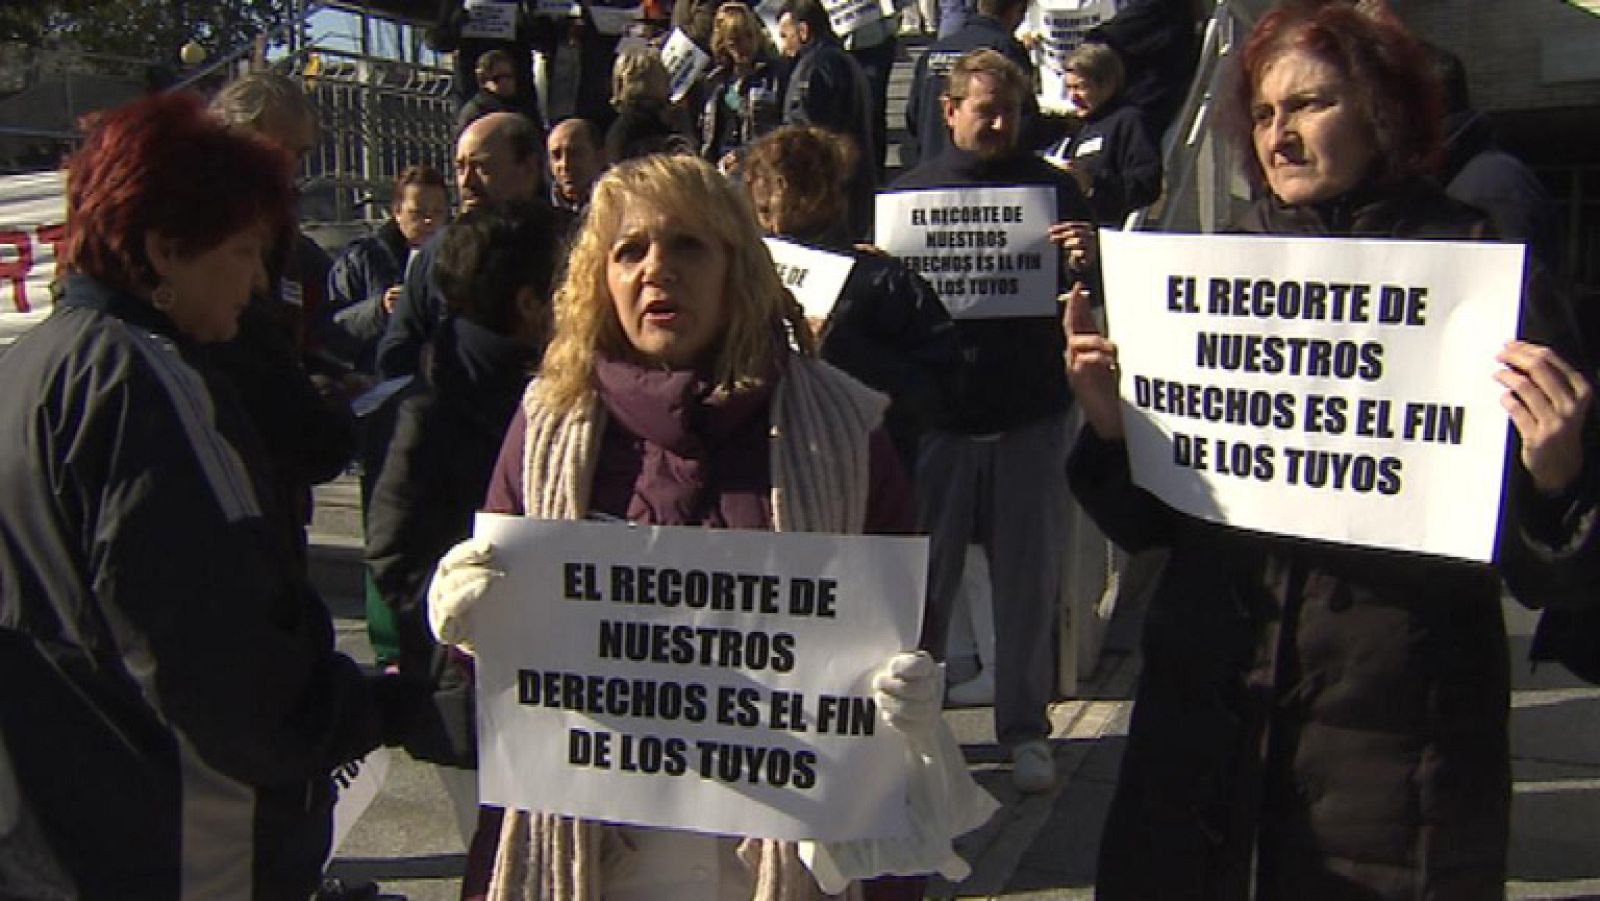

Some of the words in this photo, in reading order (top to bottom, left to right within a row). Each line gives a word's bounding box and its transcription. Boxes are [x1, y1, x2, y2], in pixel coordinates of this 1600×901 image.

[926, 231, 1008, 248] NUESTROS
[931, 206, 999, 224] RECORTE
[1003, 206, 1024, 223] DE
[970, 278, 1019, 295] TUYOS
[1017, 253, 1041, 271] FIN
[1167, 275, 1199, 314] EL
[1208, 277, 1370, 323] RECORTE
[1378, 285, 1428, 326] DE
[1196, 331, 1384, 381] NUESTROS
[1134, 375, 1295, 430] DERECHOS
[1304, 393, 1348, 434] ES
[1356, 399, 1395, 439] EL
[1403, 402, 1466, 445] FIN
[1172, 432, 1209, 471] DE
[1216, 440, 1275, 482] LOS
[1283, 447, 1403, 496] TUYOS
[564, 563, 602, 600] EL
[610, 565, 780, 615] RECORTE
[789, 577, 837, 618] DE
[599, 620, 795, 673] NUESTROS
[518, 668, 707, 722] DERECHOS
[716, 687, 760, 728] ES
[769, 692, 808, 733] EL
[816, 694, 876, 736] FIN
[568, 728, 611, 771] DE
[620, 734, 687, 778] LOS
[698, 740, 816, 790] TUYOS
